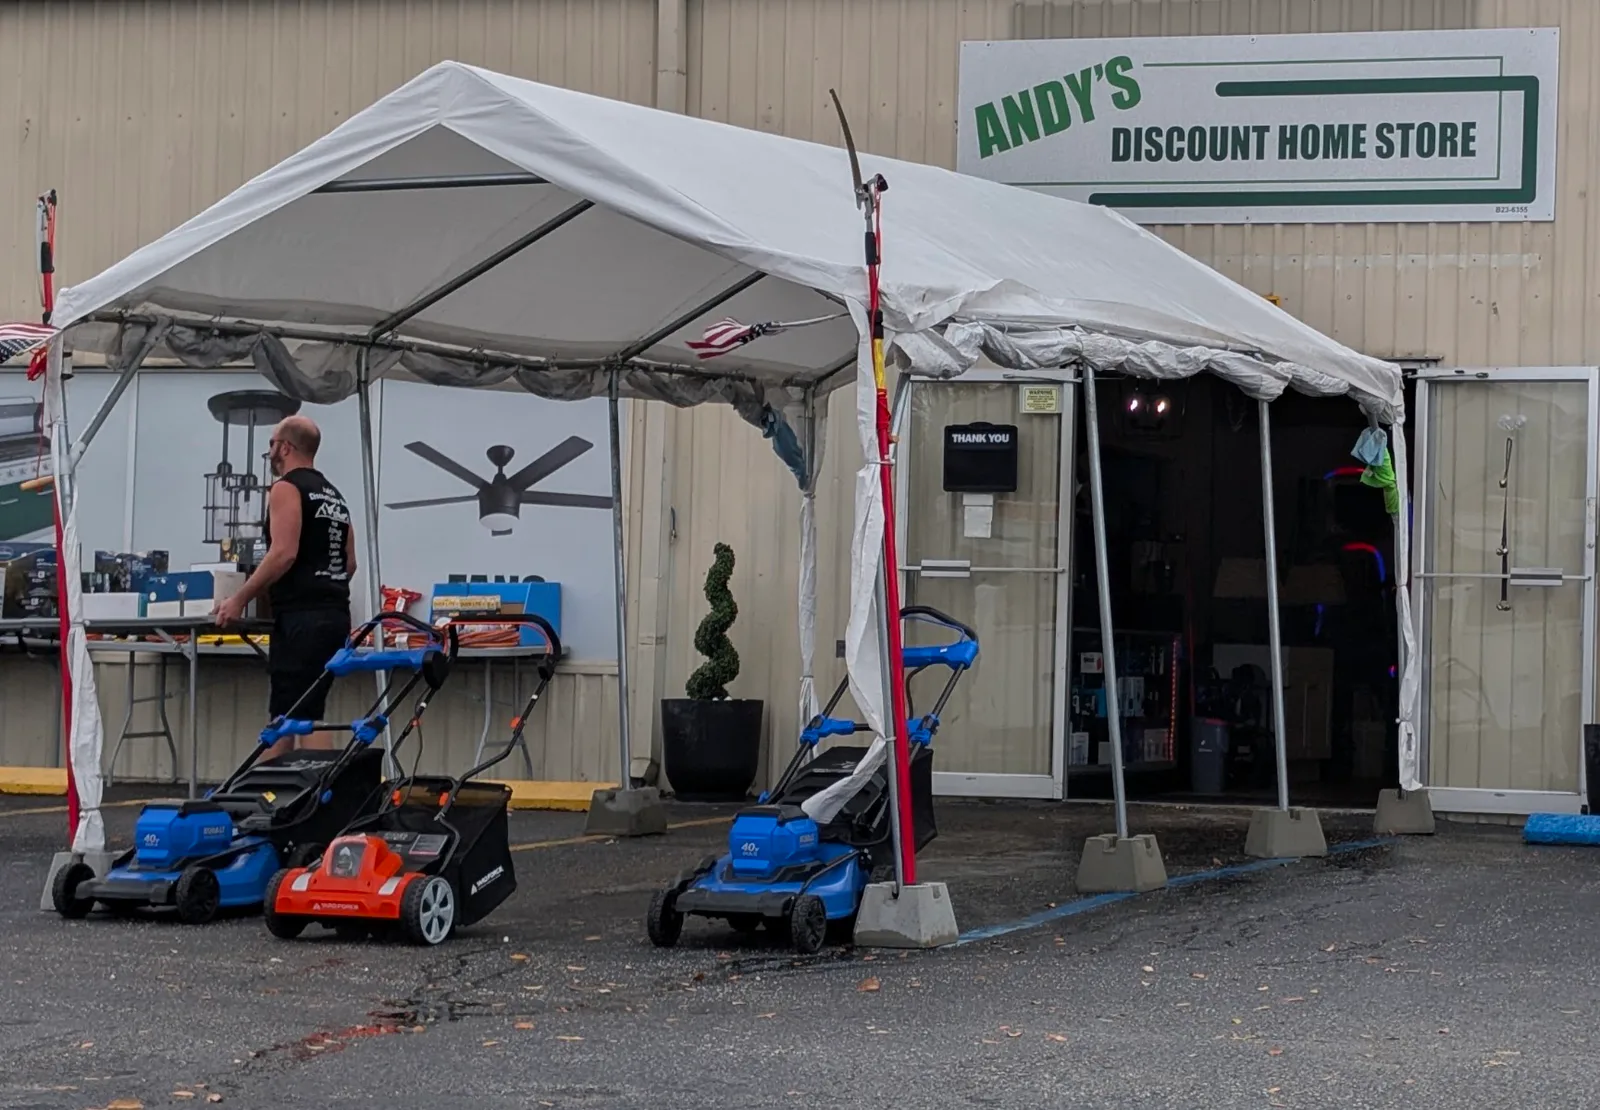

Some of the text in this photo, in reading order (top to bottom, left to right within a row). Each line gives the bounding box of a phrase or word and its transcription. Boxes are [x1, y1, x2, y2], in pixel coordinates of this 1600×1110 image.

[974, 55, 1142, 159] ANDY'S
[1111, 121, 1477, 163] DISCOUNT HOME STORE
[952, 433, 1010, 443] THANK YOU
